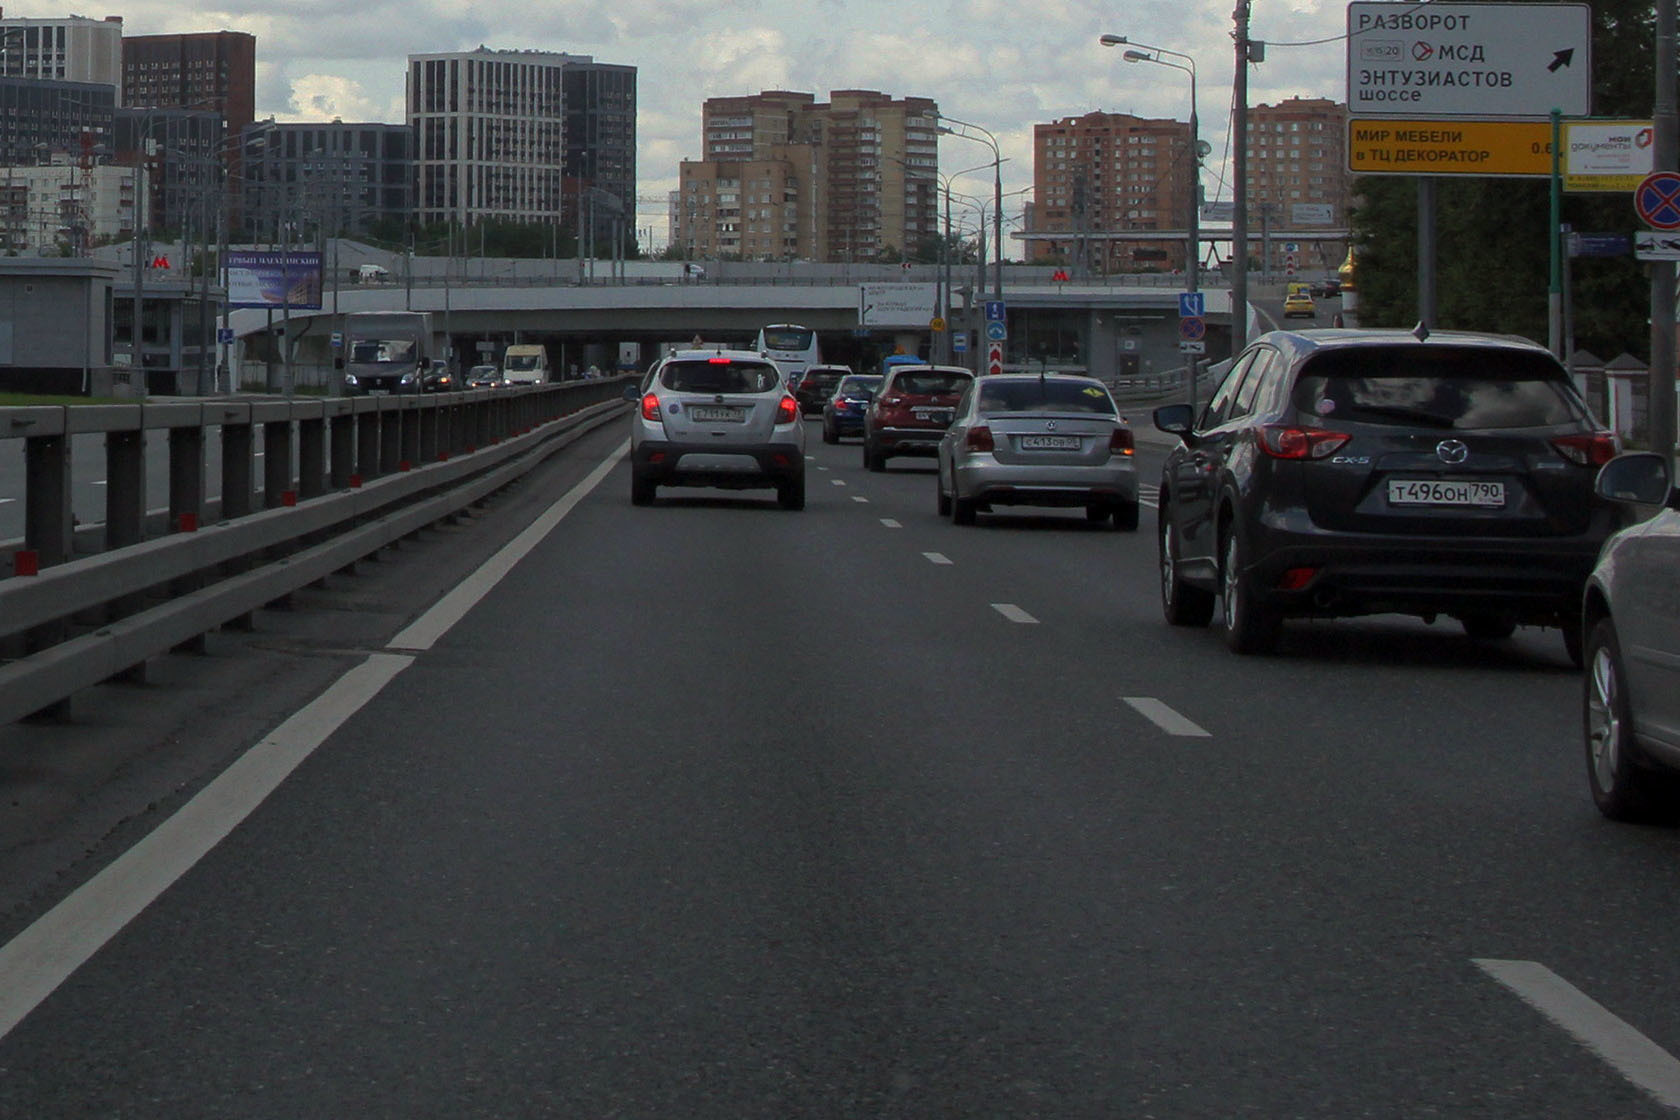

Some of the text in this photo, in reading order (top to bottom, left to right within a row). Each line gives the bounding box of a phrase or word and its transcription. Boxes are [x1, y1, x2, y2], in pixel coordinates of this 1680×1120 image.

[1359, 14, 1471, 31] РАЗВОРОТ
[1439, 44, 1486, 63] МСД
[1359, 70, 1513, 88] ЭНТУЗИАСТОВ
[1359, 89, 1422, 101] шоссе
[1356, 130, 1463, 143] МИР МЕБЕЛИ
[1356, 150, 1491, 164] в ТЦ ДЕКОРАТОР
[1395, 483, 1500, 501] Т496ОН 790
